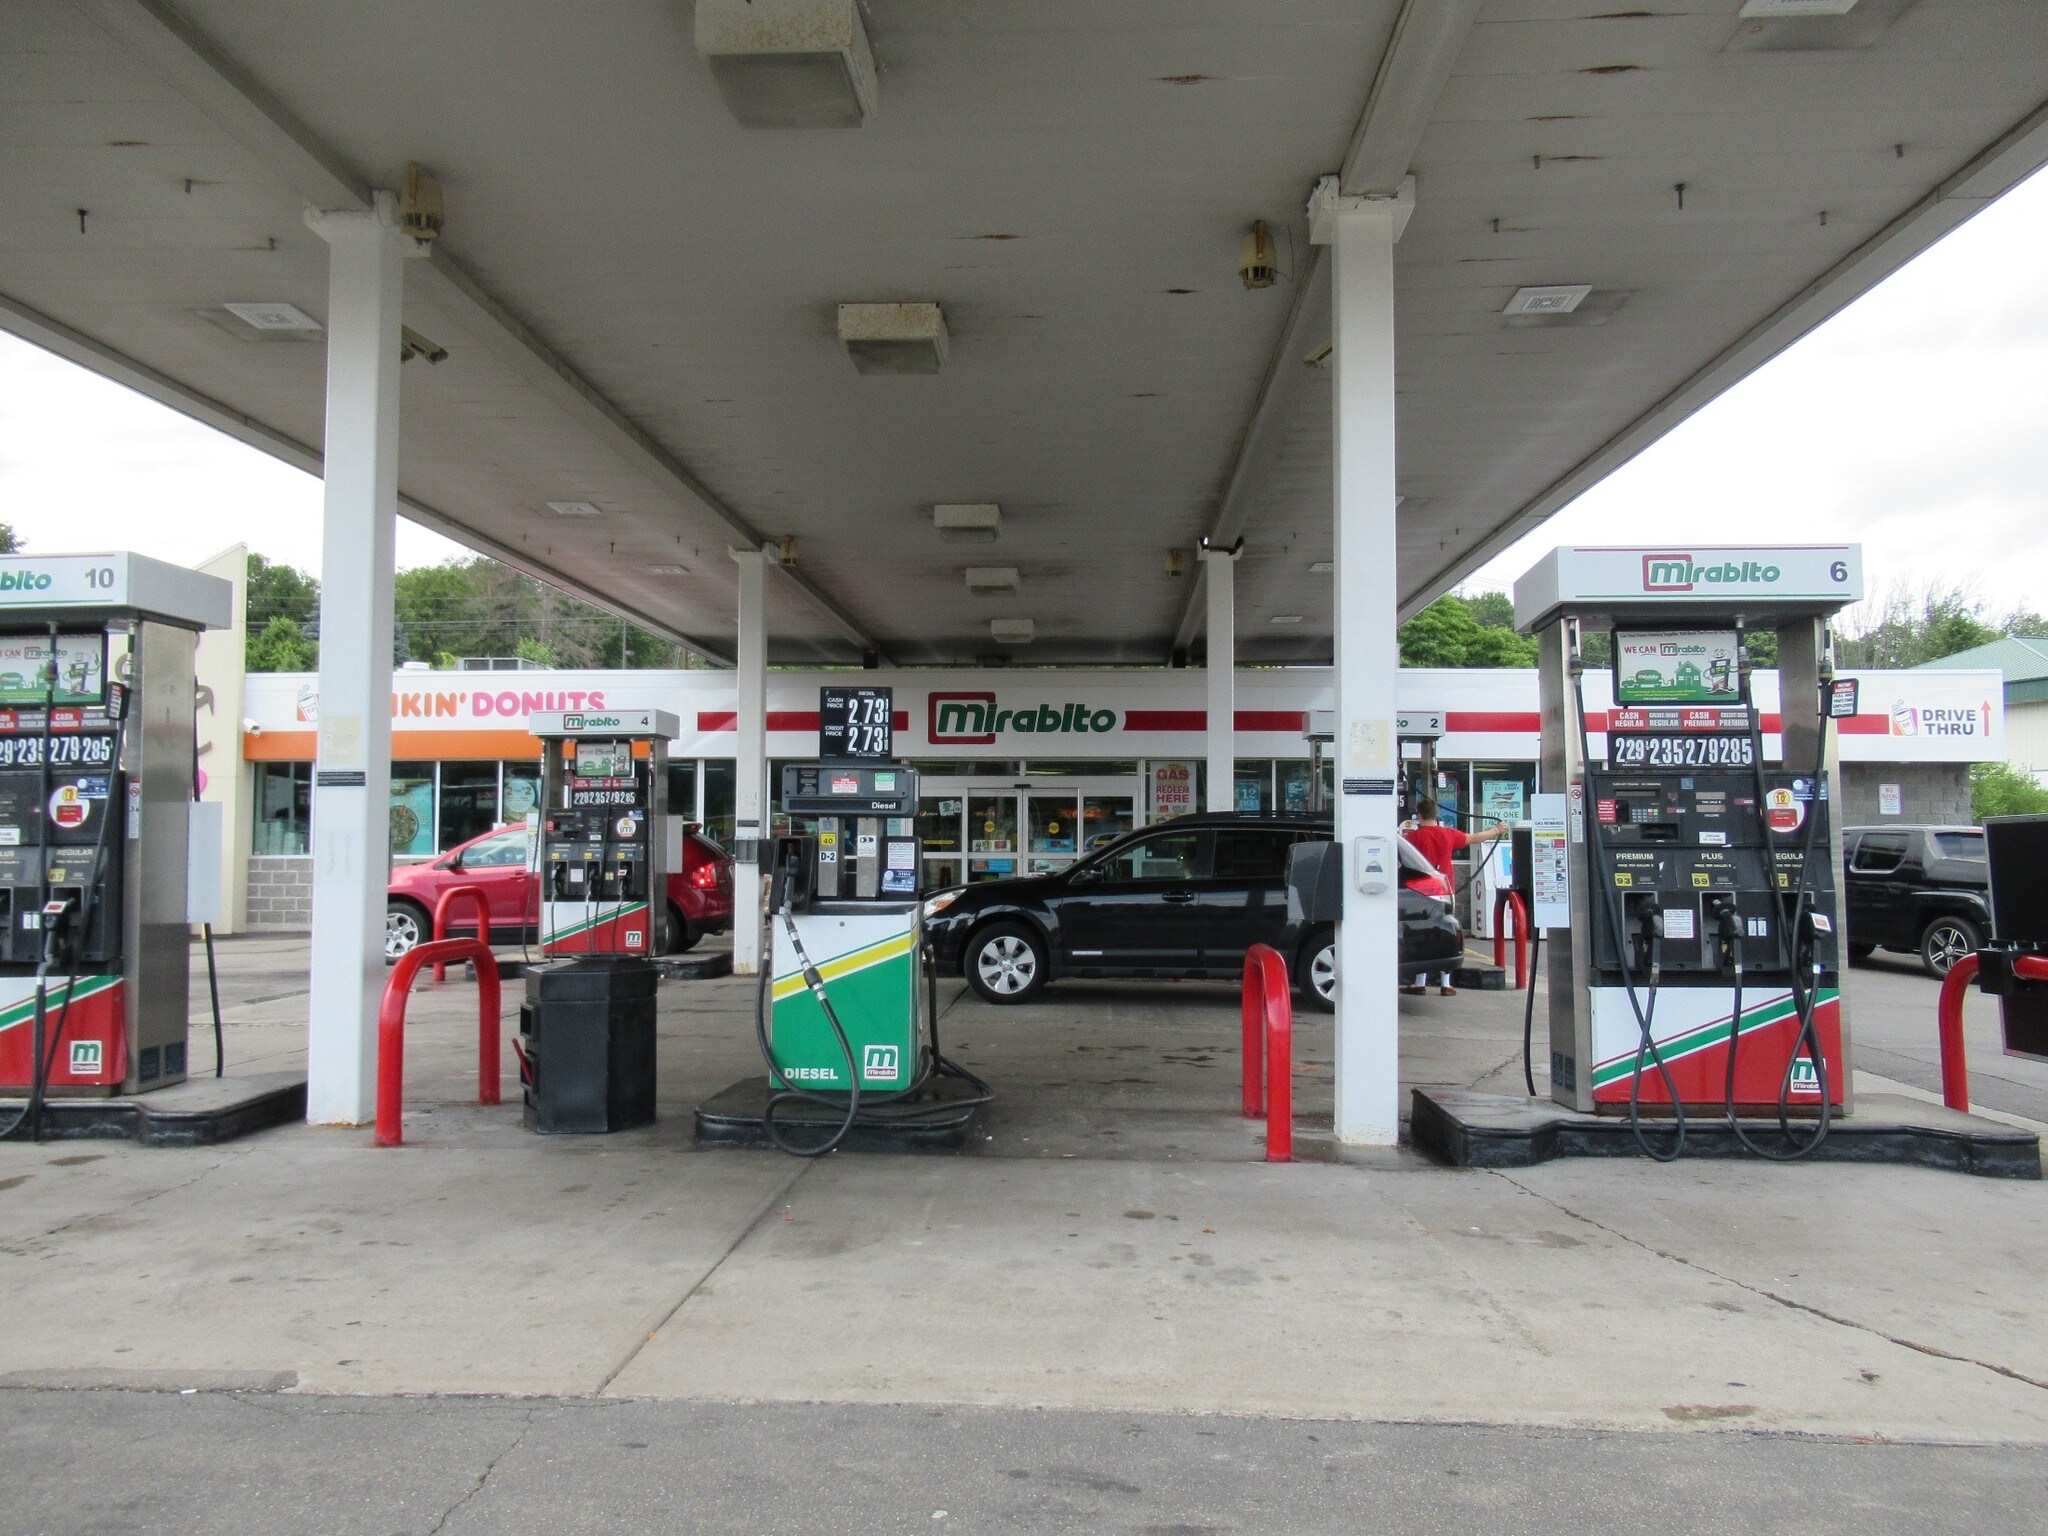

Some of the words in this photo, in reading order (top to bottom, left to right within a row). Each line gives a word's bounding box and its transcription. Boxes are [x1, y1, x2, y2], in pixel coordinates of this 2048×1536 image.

[1830, 560, 1848, 582] 6
[0, 570, 52, 590] bito
[85, 568, 114, 588] 10
[392, 693, 467, 717] KIN'
[472, 691, 606, 717] DONUTS
[1619, 711, 1639, 719] CASH
[1689, 711, 1709, 719] CASH
[1922, 709, 1976, 721] DRIVE
[641, 716, 649, 726] 4
[1430, 718, 1439, 728] 2
[1615, 719, 1644, 727] REGULAR
[1650, 719, 1679, 727] REGULAR
[1684, 719, 1715, 727] PREMIUM
[1925, 723, 1974, 735] THRU
[1156, 769, 1189, 780] GAS
[1156, 785, 1189, 793] REDEEM
[1242, 788, 1256, 799] 12
[1156, 795, 1189, 803] HERE
[871, 801, 896, 810] Diesel
[820, 852, 835, 861] D-2
[784, 1068, 838, 1079] DIESEL
